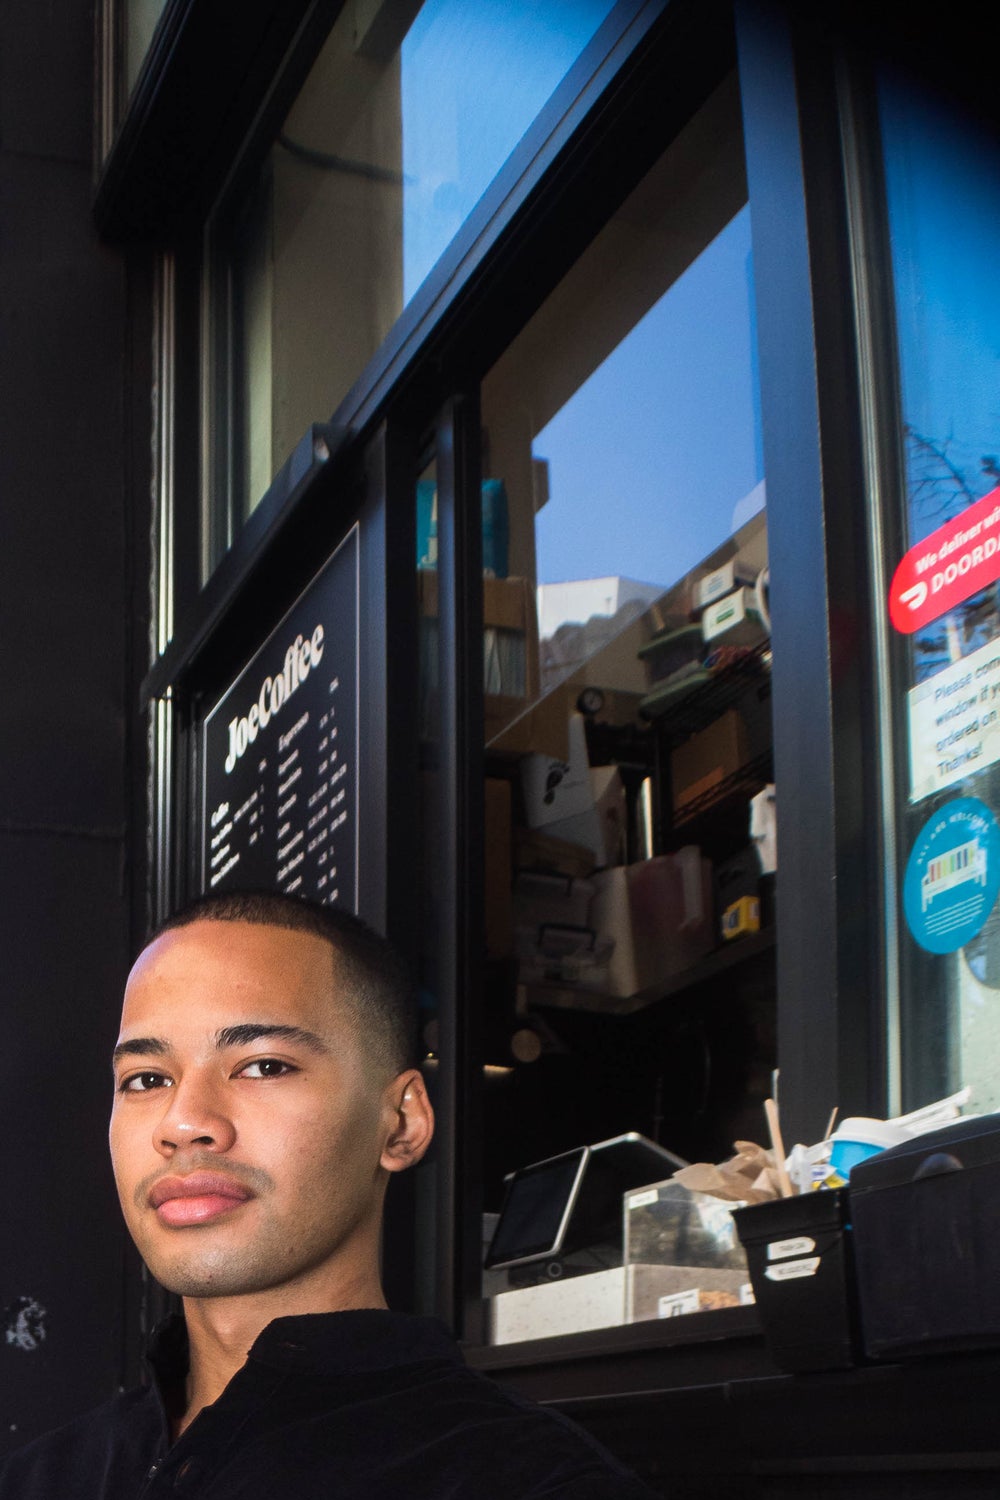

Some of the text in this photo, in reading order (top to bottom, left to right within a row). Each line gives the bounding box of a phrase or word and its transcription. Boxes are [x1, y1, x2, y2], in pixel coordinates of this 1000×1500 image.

[915, 553, 938, 575] We
[938, 521, 983, 558] deliver
[934, 673, 972, 700] Please
[936, 695, 977, 726] window
[980, 684, 989, 702] if
[936, 709, 997, 752] ordered on
[937, 740, 983, 776] Thanks!
